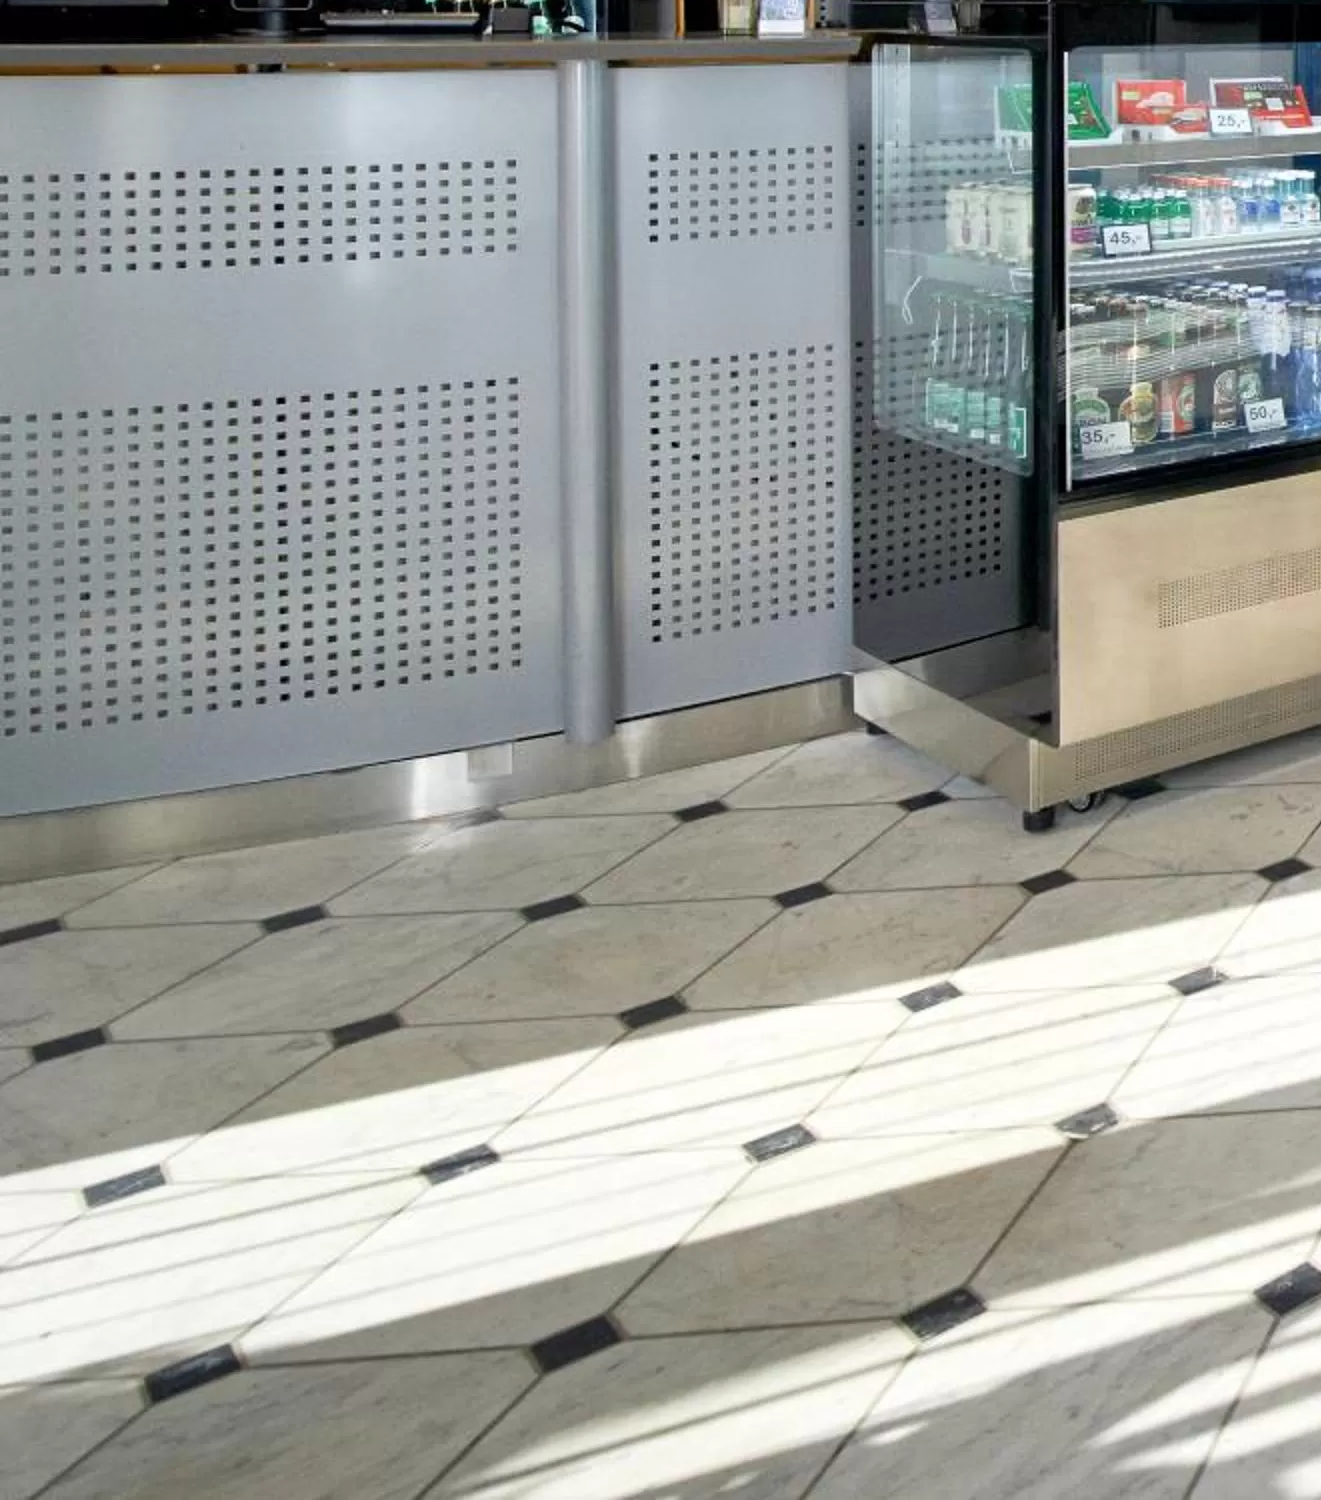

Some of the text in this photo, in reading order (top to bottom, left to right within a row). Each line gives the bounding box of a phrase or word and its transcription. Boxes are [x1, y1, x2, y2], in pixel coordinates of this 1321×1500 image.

[1217, 114, 1246, 128] 25,-
[1108, 231, 1144, 245] 45,-
[1081, 429, 1116, 445] 35,-
